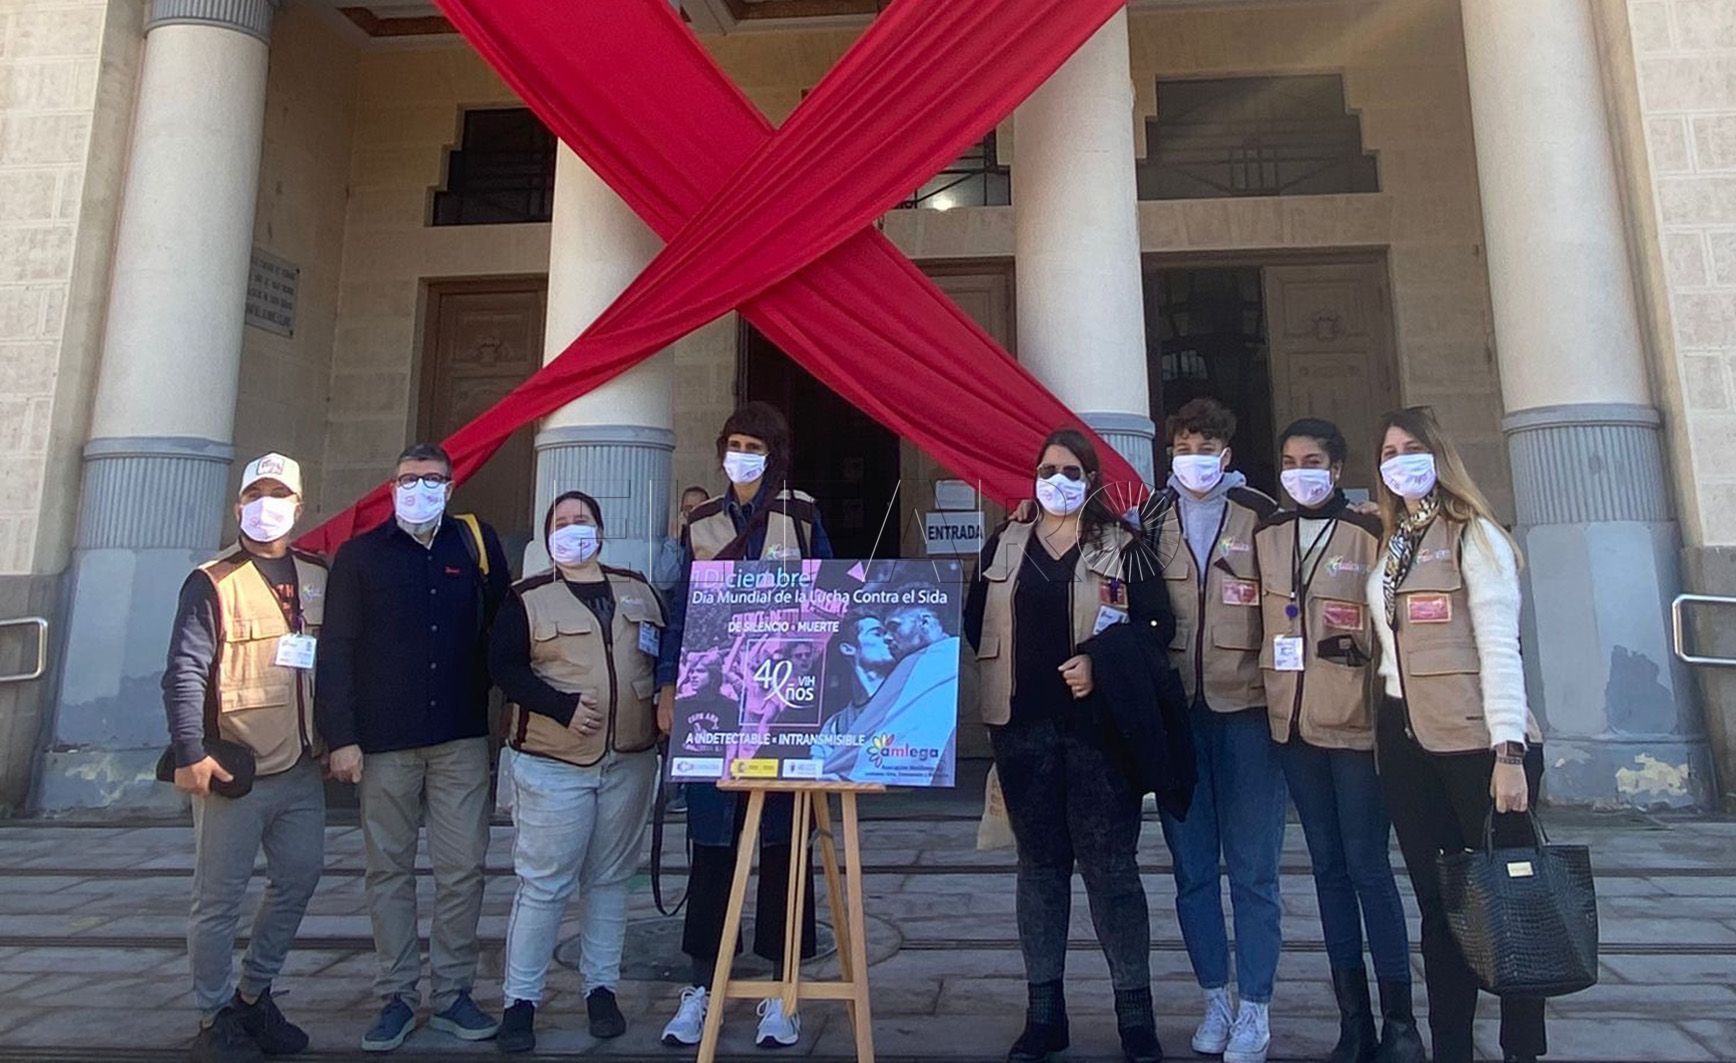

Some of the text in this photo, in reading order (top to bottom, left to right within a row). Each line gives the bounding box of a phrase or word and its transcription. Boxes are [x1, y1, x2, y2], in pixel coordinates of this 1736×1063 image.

[928, 525, 983, 541] ENTRADA
[718, 590, 772, 605] Mundial
[774, 590, 792, 604] de
[795, 590, 807, 604] la
[809, 589, 850, 604] Lucha
[853, 590, 899, 604] Contra
[902, 590, 915, 603] el
[918, 590, 948, 604] Sida
[743, 621, 790, 633] SILENCIO
[797, 621, 840, 633] MUERTE
[798, 675, 816, 687] VIH
[685, 732, 694, 745] A
[695, 732, 771, 746] INDETECTABLE
[778, 733, 866, 746] INTRANSMISIBLE
[880, 743, 940, 761] amlega
